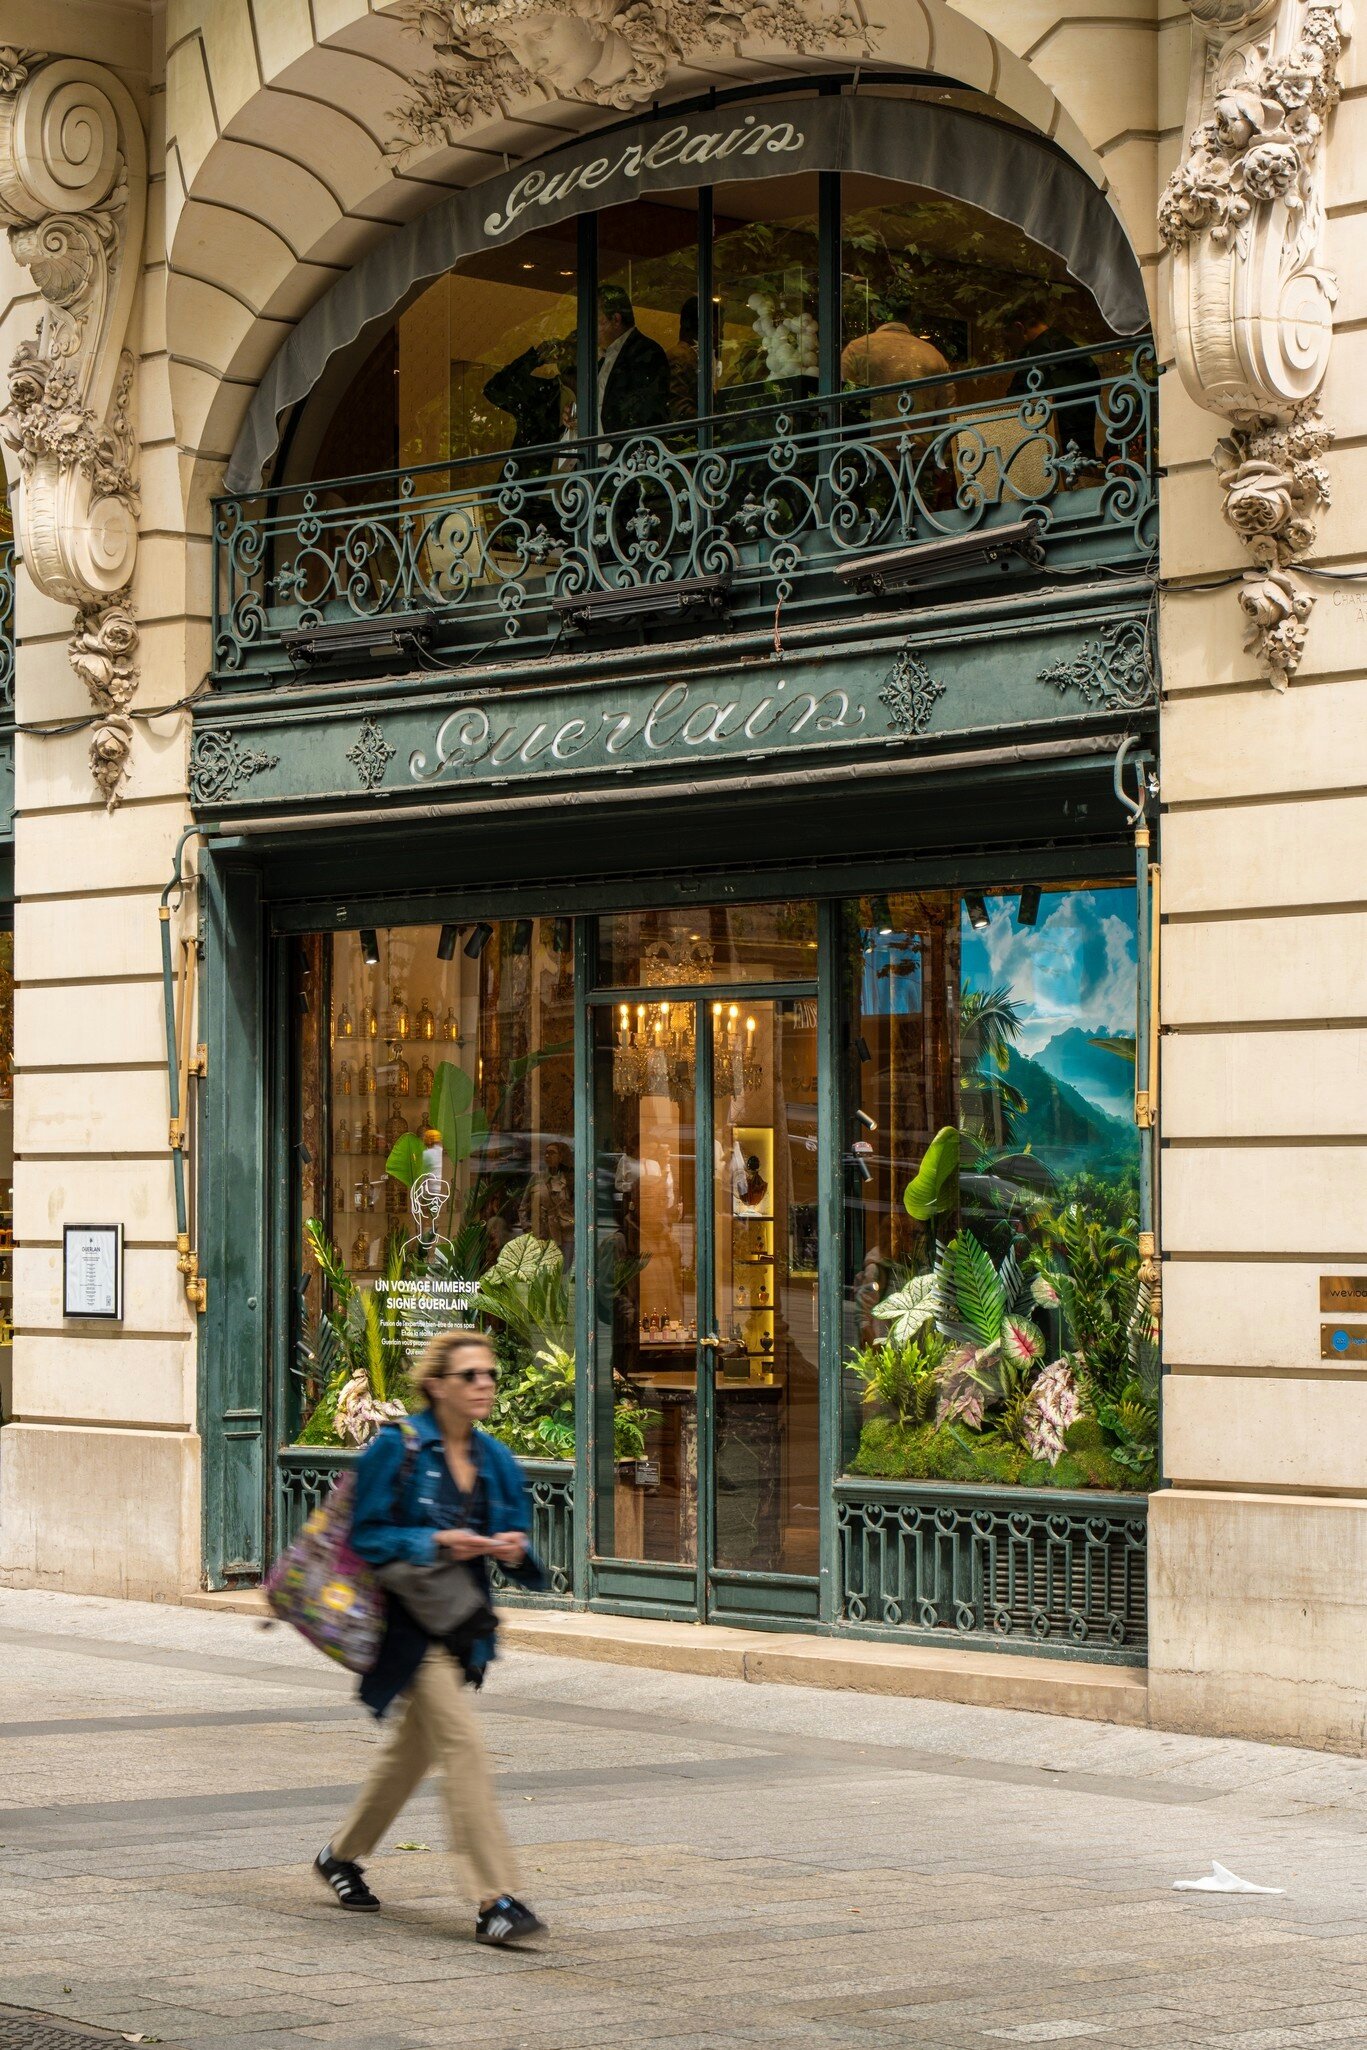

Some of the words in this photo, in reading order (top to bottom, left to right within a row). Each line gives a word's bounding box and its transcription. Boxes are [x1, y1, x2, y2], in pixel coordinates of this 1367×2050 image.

[484, 115, 805, 236] Guerlain
[409, 679, 867, 782] Guerlain
[375, 1280, 389, 1292] UN
[391, 1280, 430, 1292] VOYAGE
[432, 1281, 480, 1293] IMMERSIF
[386, 1295, 416, 1310] SIGNÉ
[418, 1298, 468, 1311] GUERLAIN
